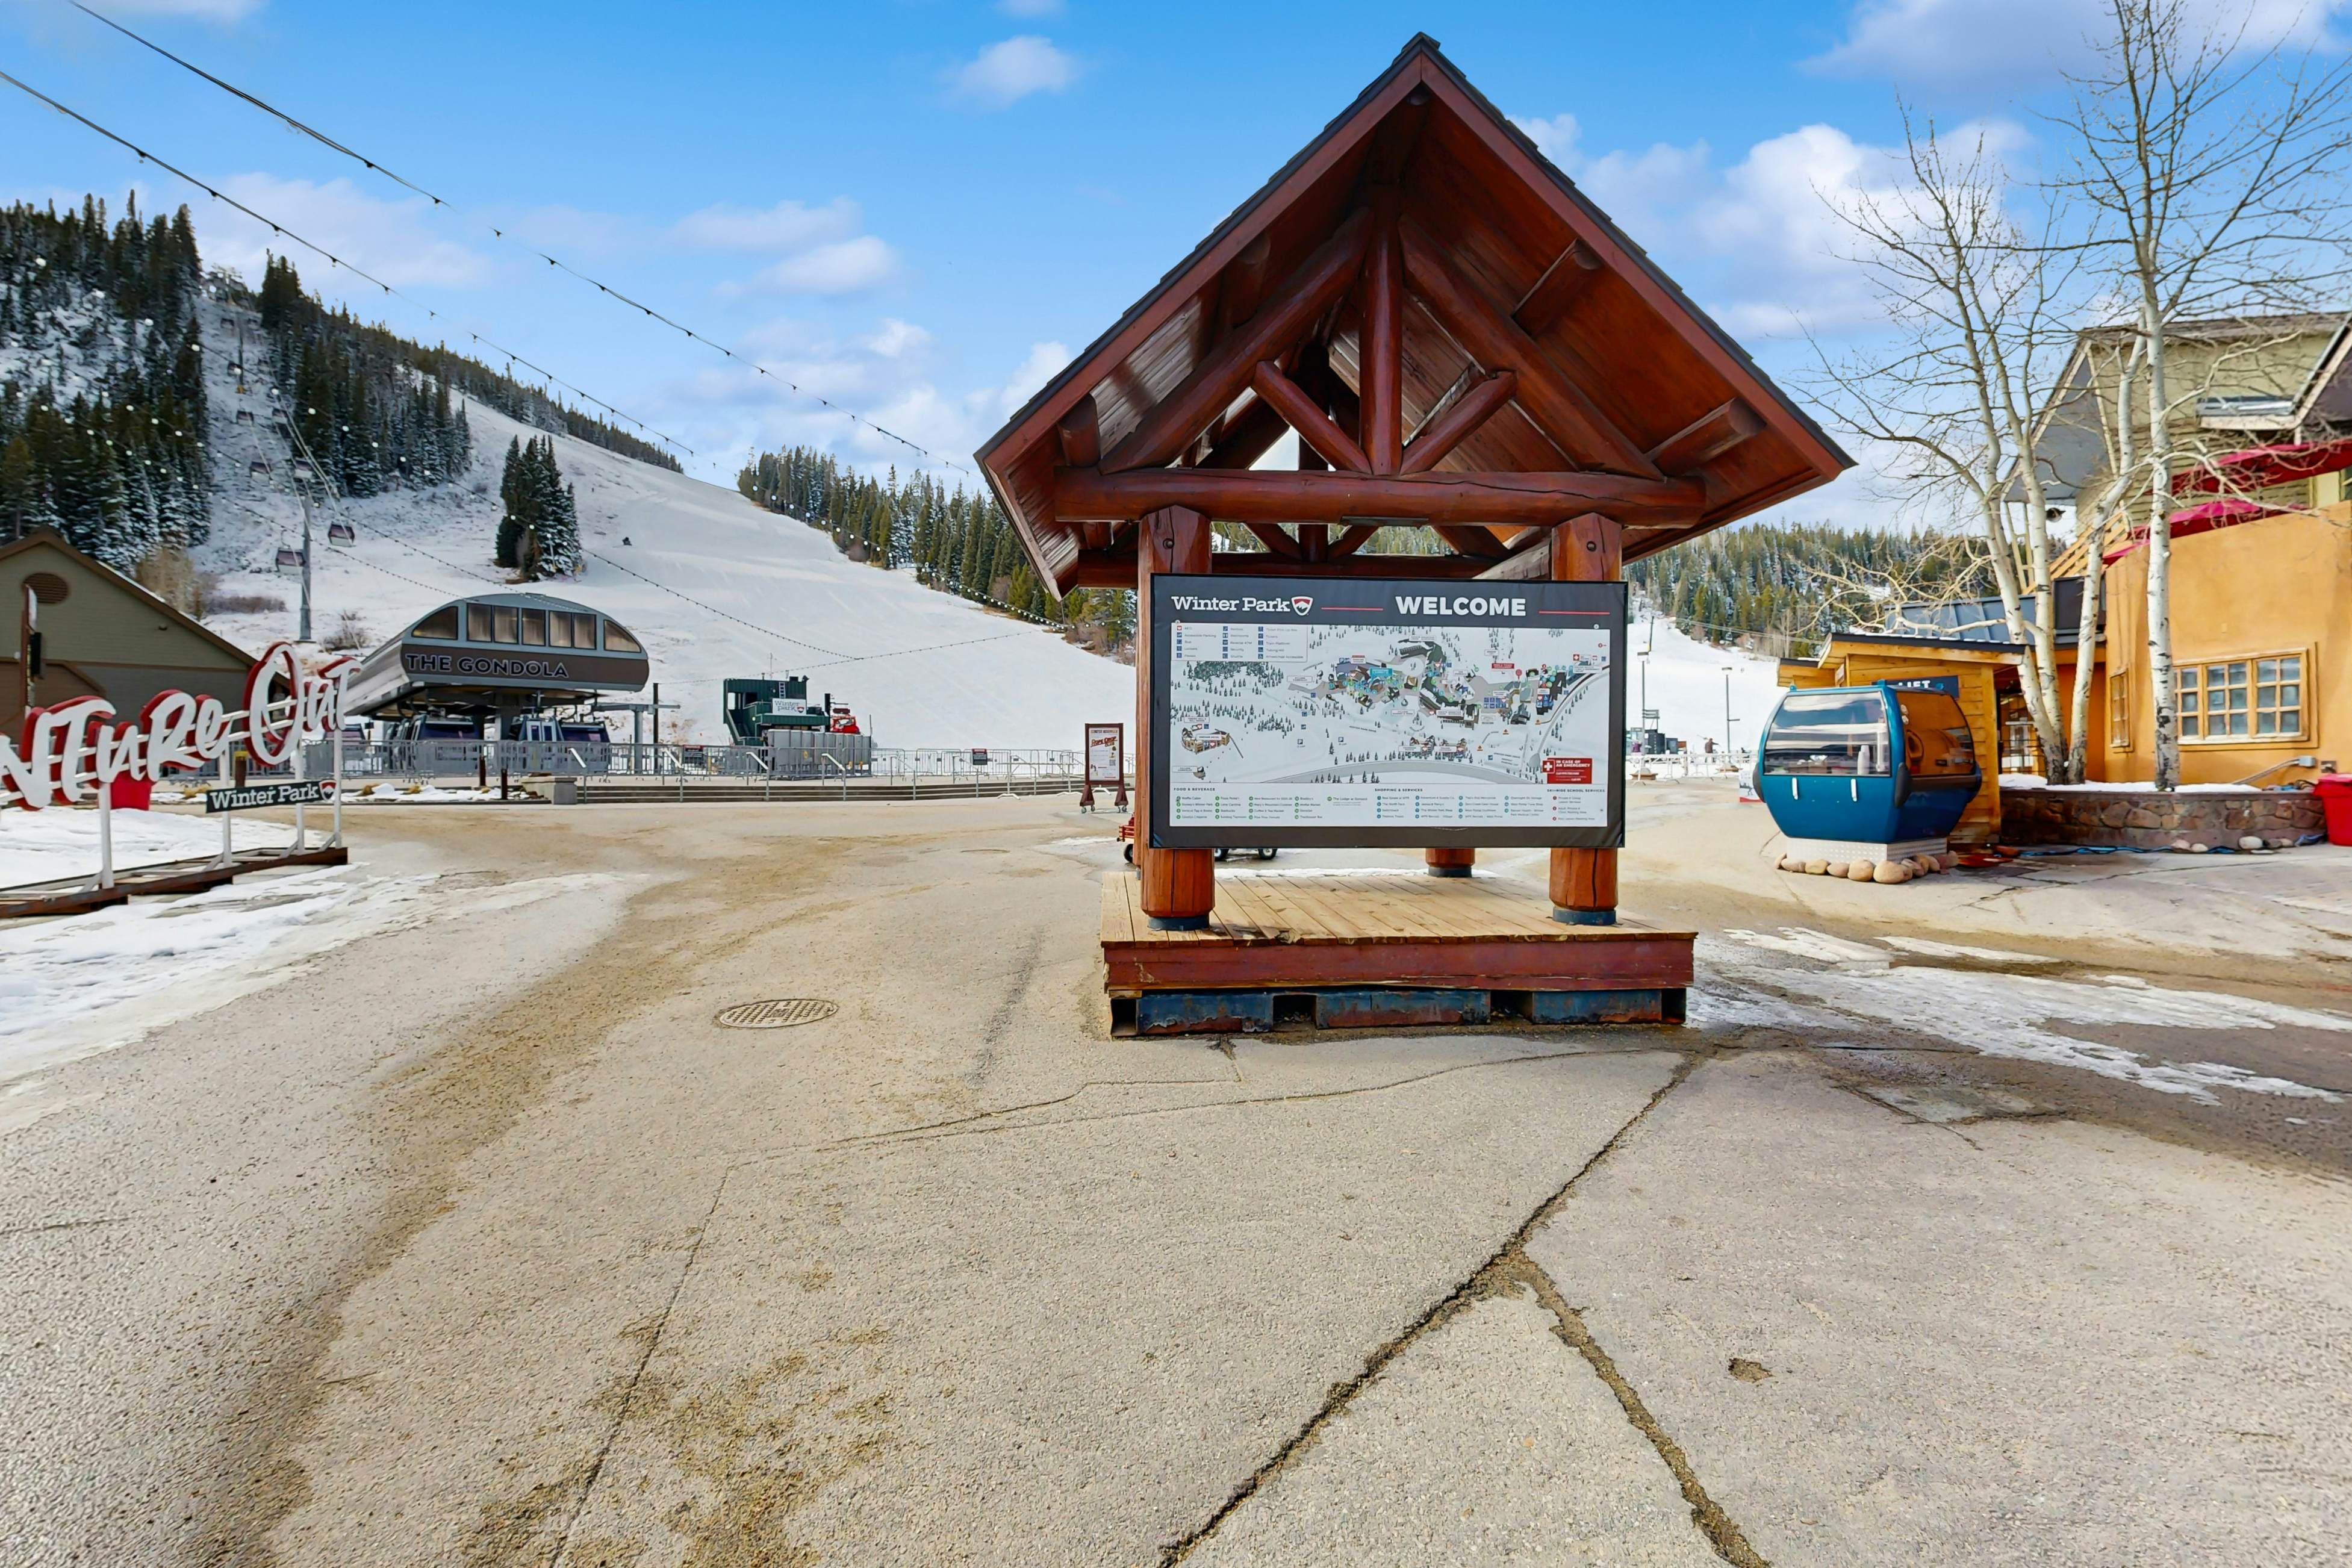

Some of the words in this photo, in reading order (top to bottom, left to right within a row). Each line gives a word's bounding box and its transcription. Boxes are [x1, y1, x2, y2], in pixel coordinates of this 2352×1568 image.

[1171, 596, 1239, 611] Winter
[1242, 597, 1290, 612] Park
[1395, 596, 1526, 617] WELCOME
[405, 653, 452, 673] THE
[457, 657, 569, 679] GONDOLA
[208, 786, 275, 809] Winter
[276, 783, 318, 803] Park
